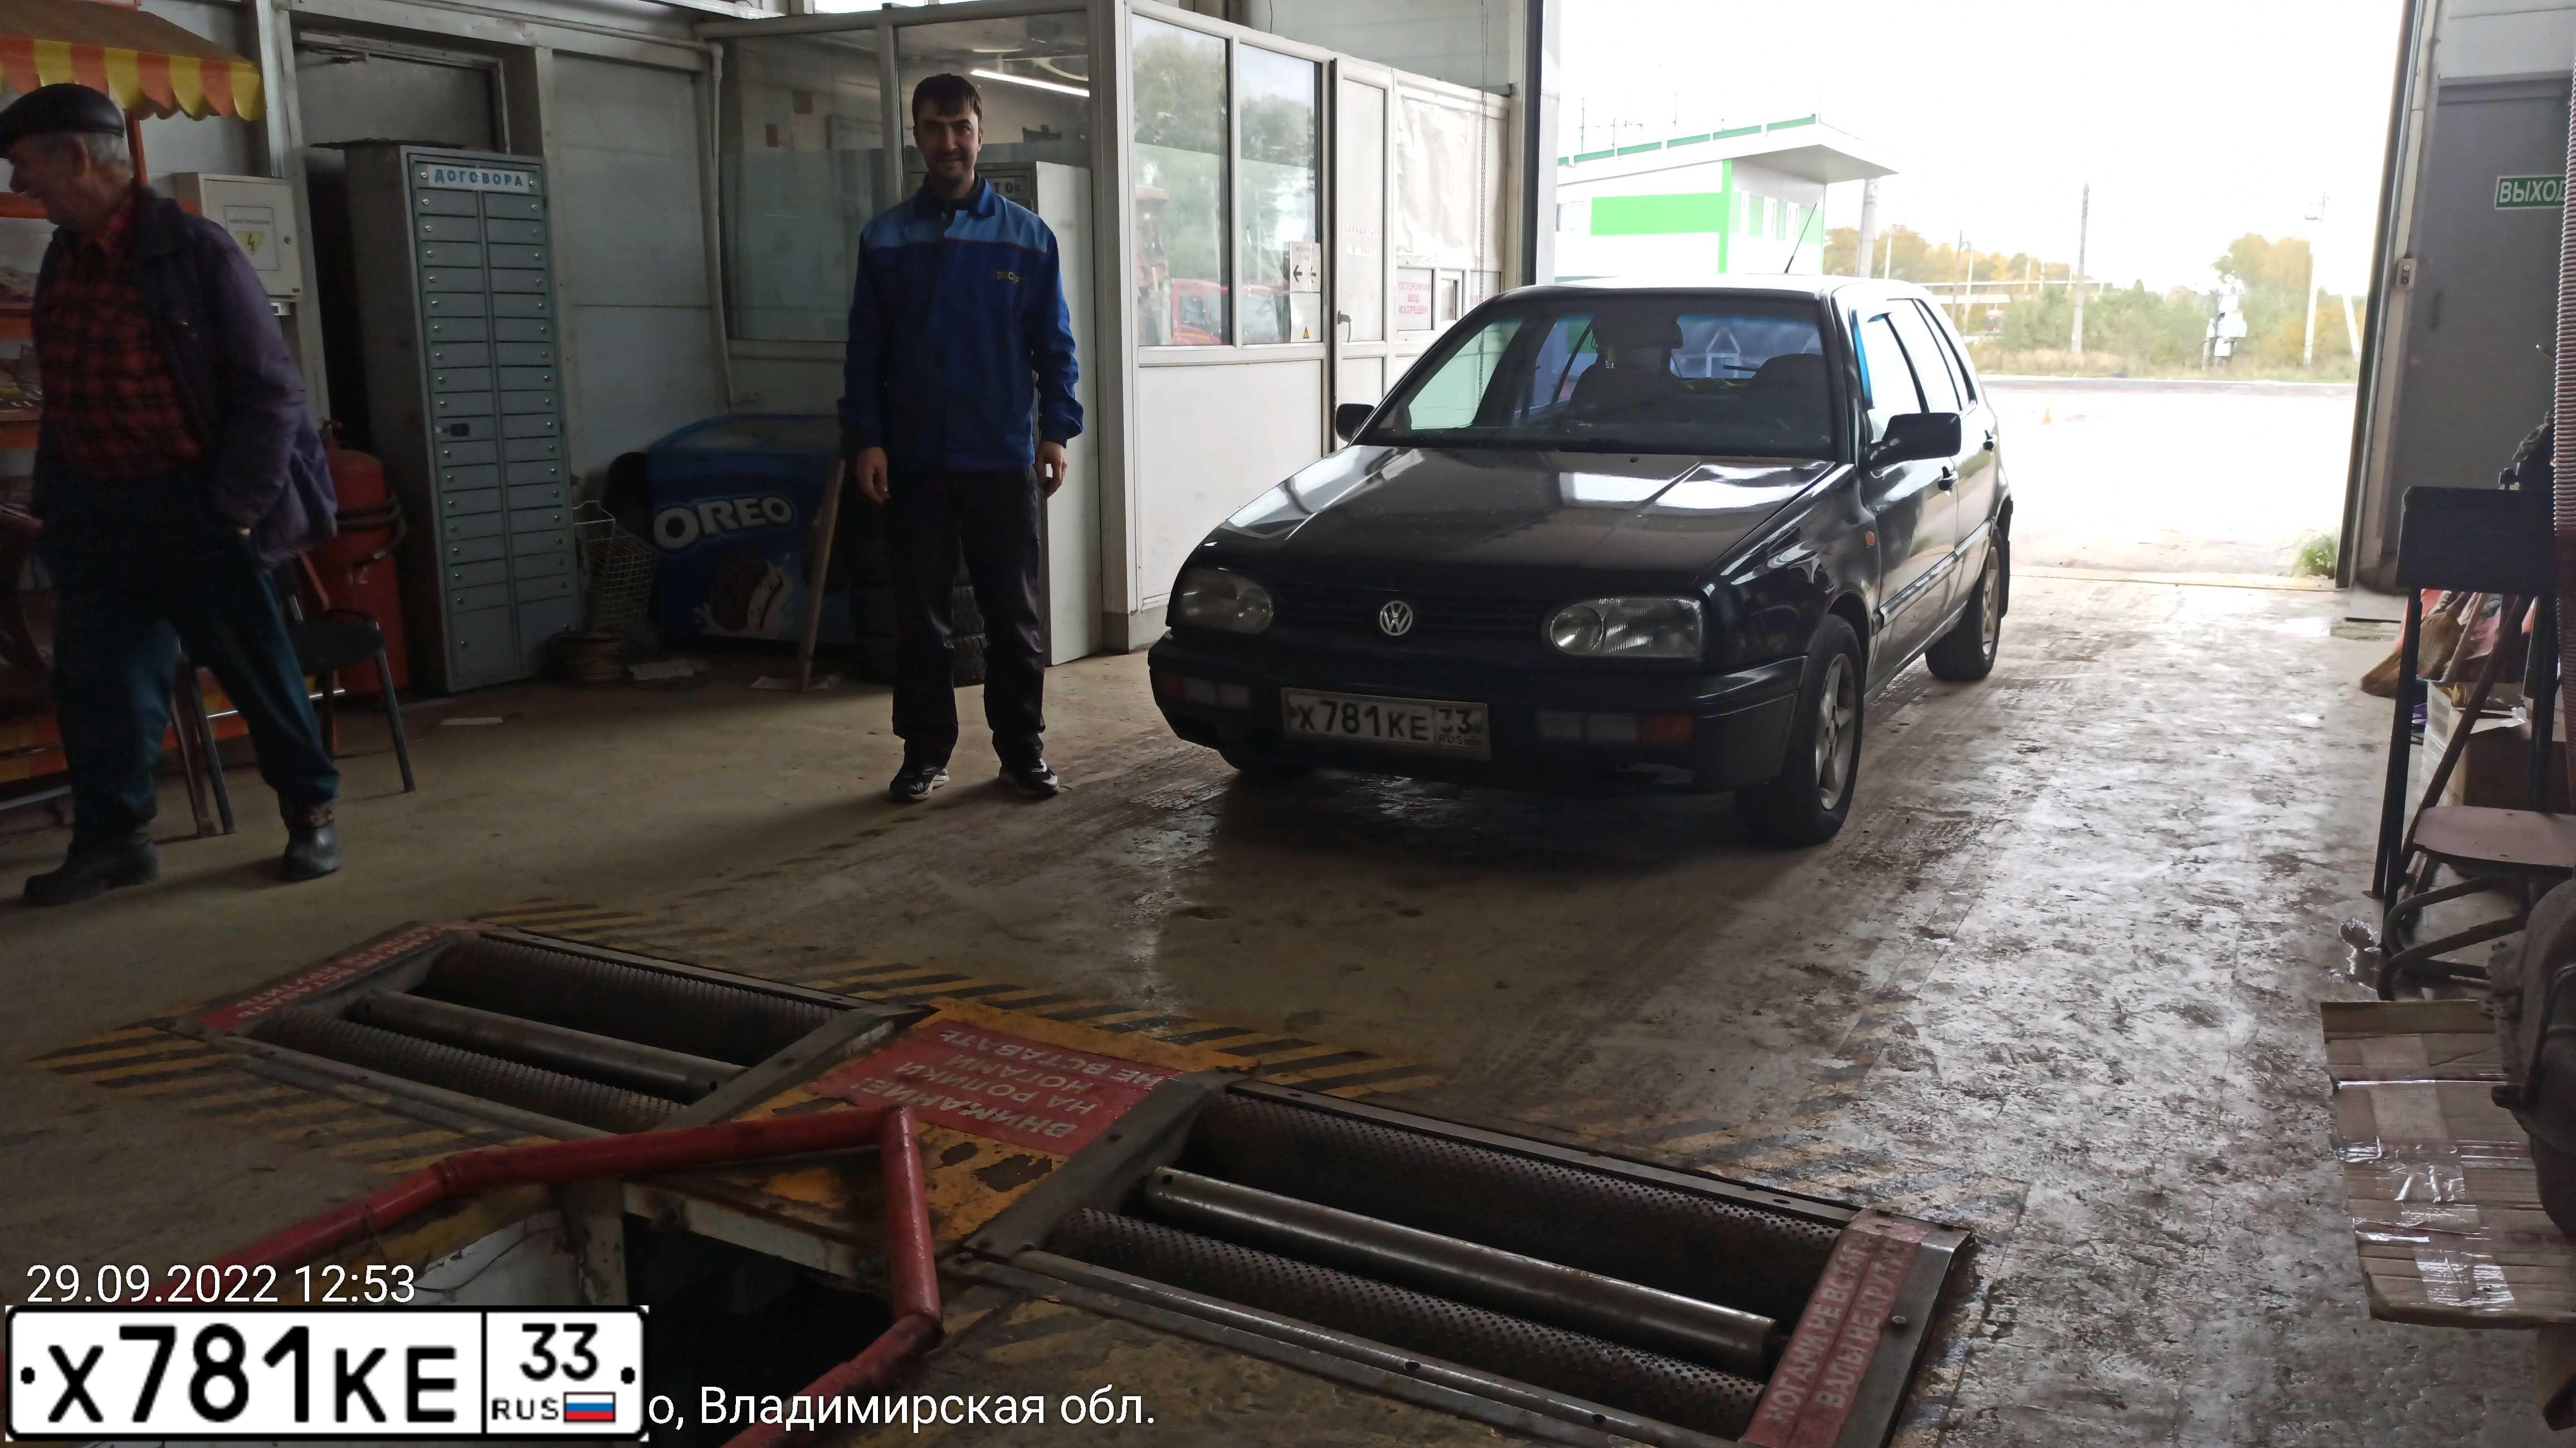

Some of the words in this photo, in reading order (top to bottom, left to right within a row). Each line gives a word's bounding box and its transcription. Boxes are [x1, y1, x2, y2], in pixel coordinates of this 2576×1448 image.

[433, 168, 524, 188] ДОГОВОРА
[653, 496, 793, 550] OREO
[1298, 699, 1428, 741] Х781КЕ
[1437, 708, 1472, 735] 33
[1438, 733, 1464, 745] RUS
[940, 1029, 1111, 1077] ВСТАВАТЬ
[892, 1060, 1041, 1103] РОЛИКИ
[946, 1055, 1094, 1094] НОГАМИ
[1111, 1069, 1165, 1090] НЕ
[850, 1077, 1080, 1138] ВНИМАНИЕ!
[1047, 1094, 1097, 1116] НА
